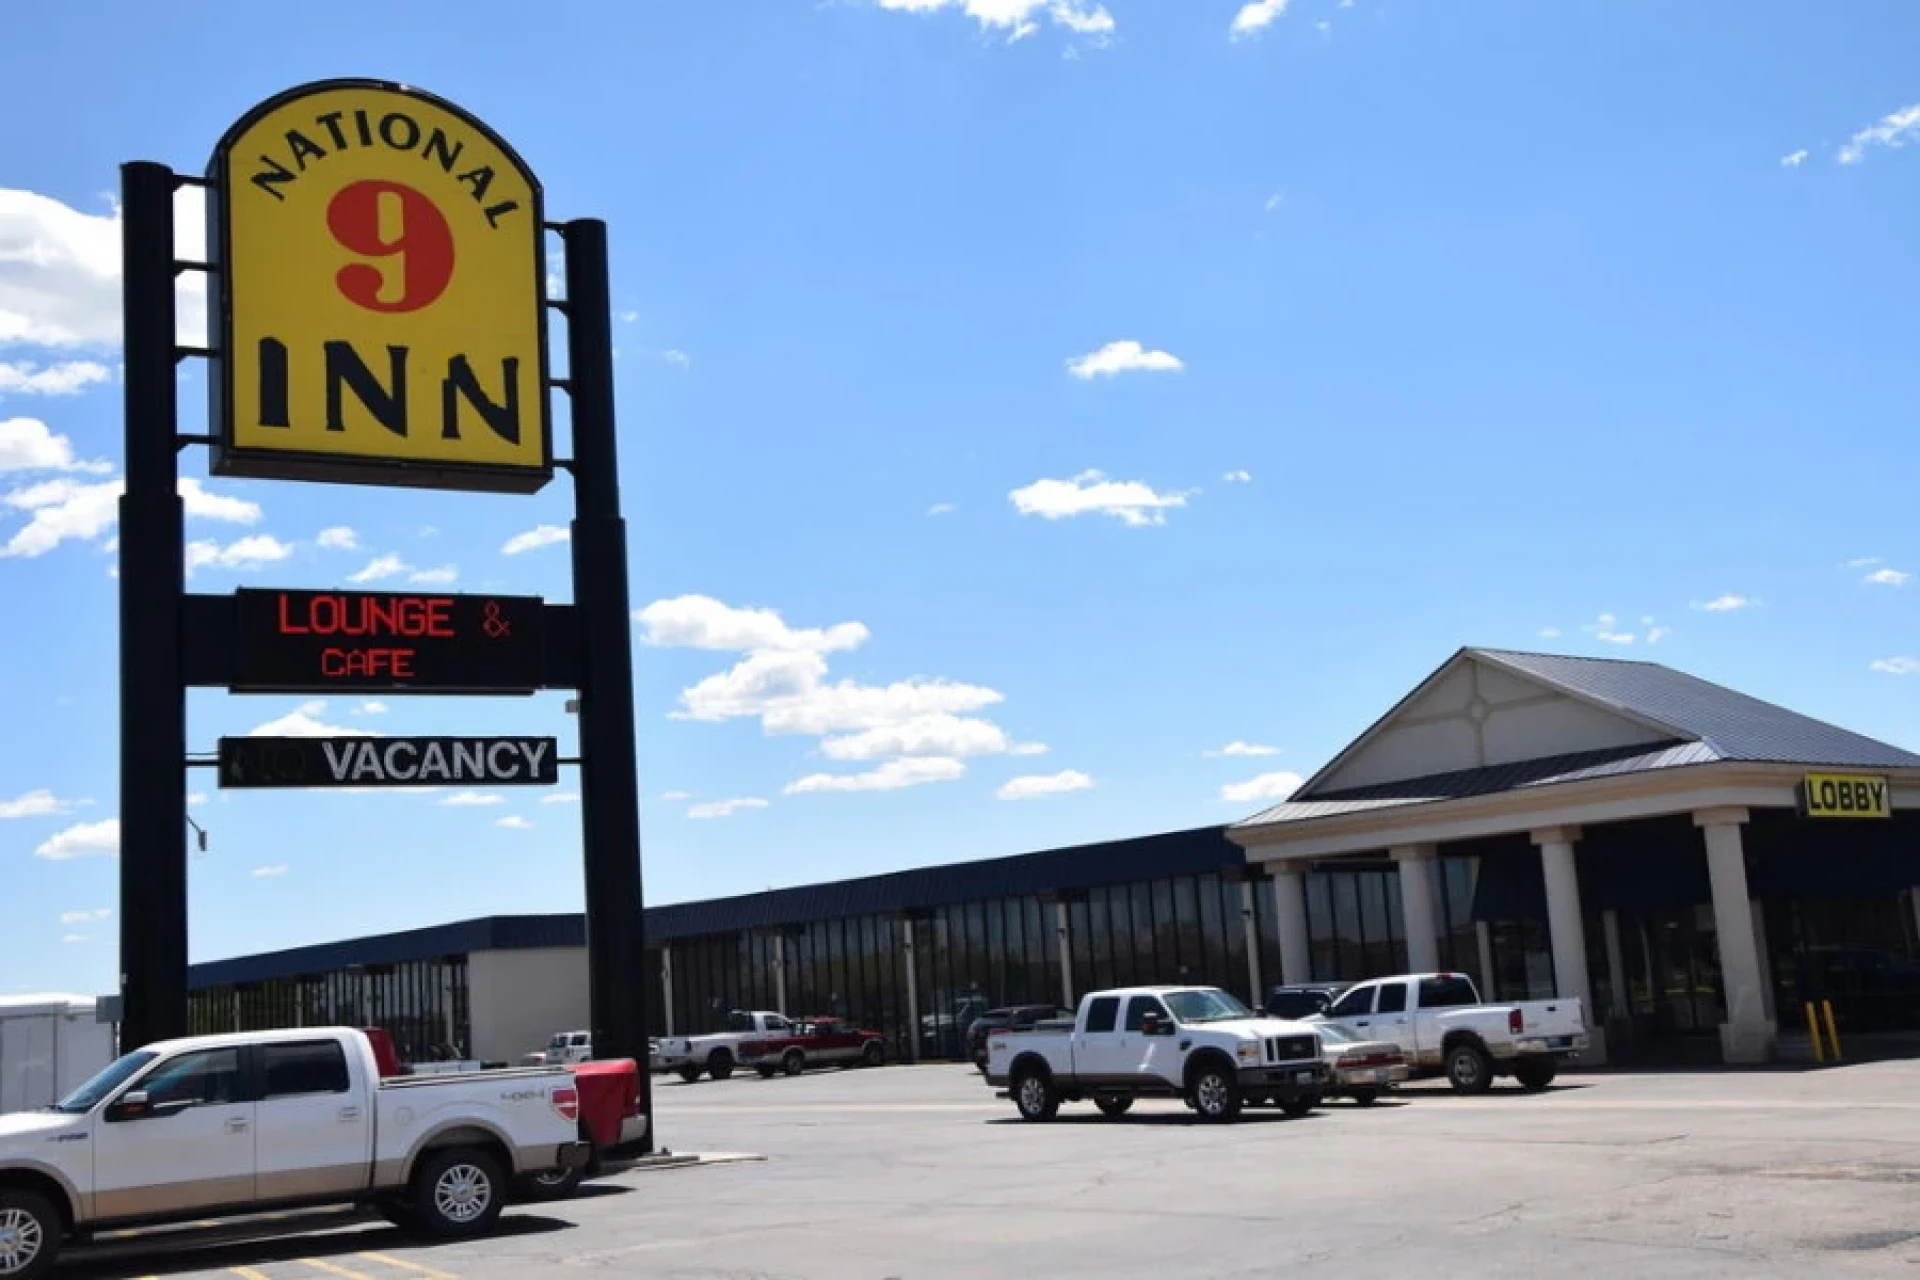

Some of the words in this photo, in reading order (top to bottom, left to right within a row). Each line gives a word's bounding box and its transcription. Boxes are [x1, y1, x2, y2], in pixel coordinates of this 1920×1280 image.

[251, 110, 519, 230] NATIONAL
[326, 179, 456, 315] 9
[258, 336, 521, 446] INN
[277, 594, 455, 637] LOUNGE
[482, 600, 512, 638] &
[321, 648, 416, 678] CAFE
[322, 741, 549, 780] VACANCY
[1808, 778, 1885, 813] LOBBY
